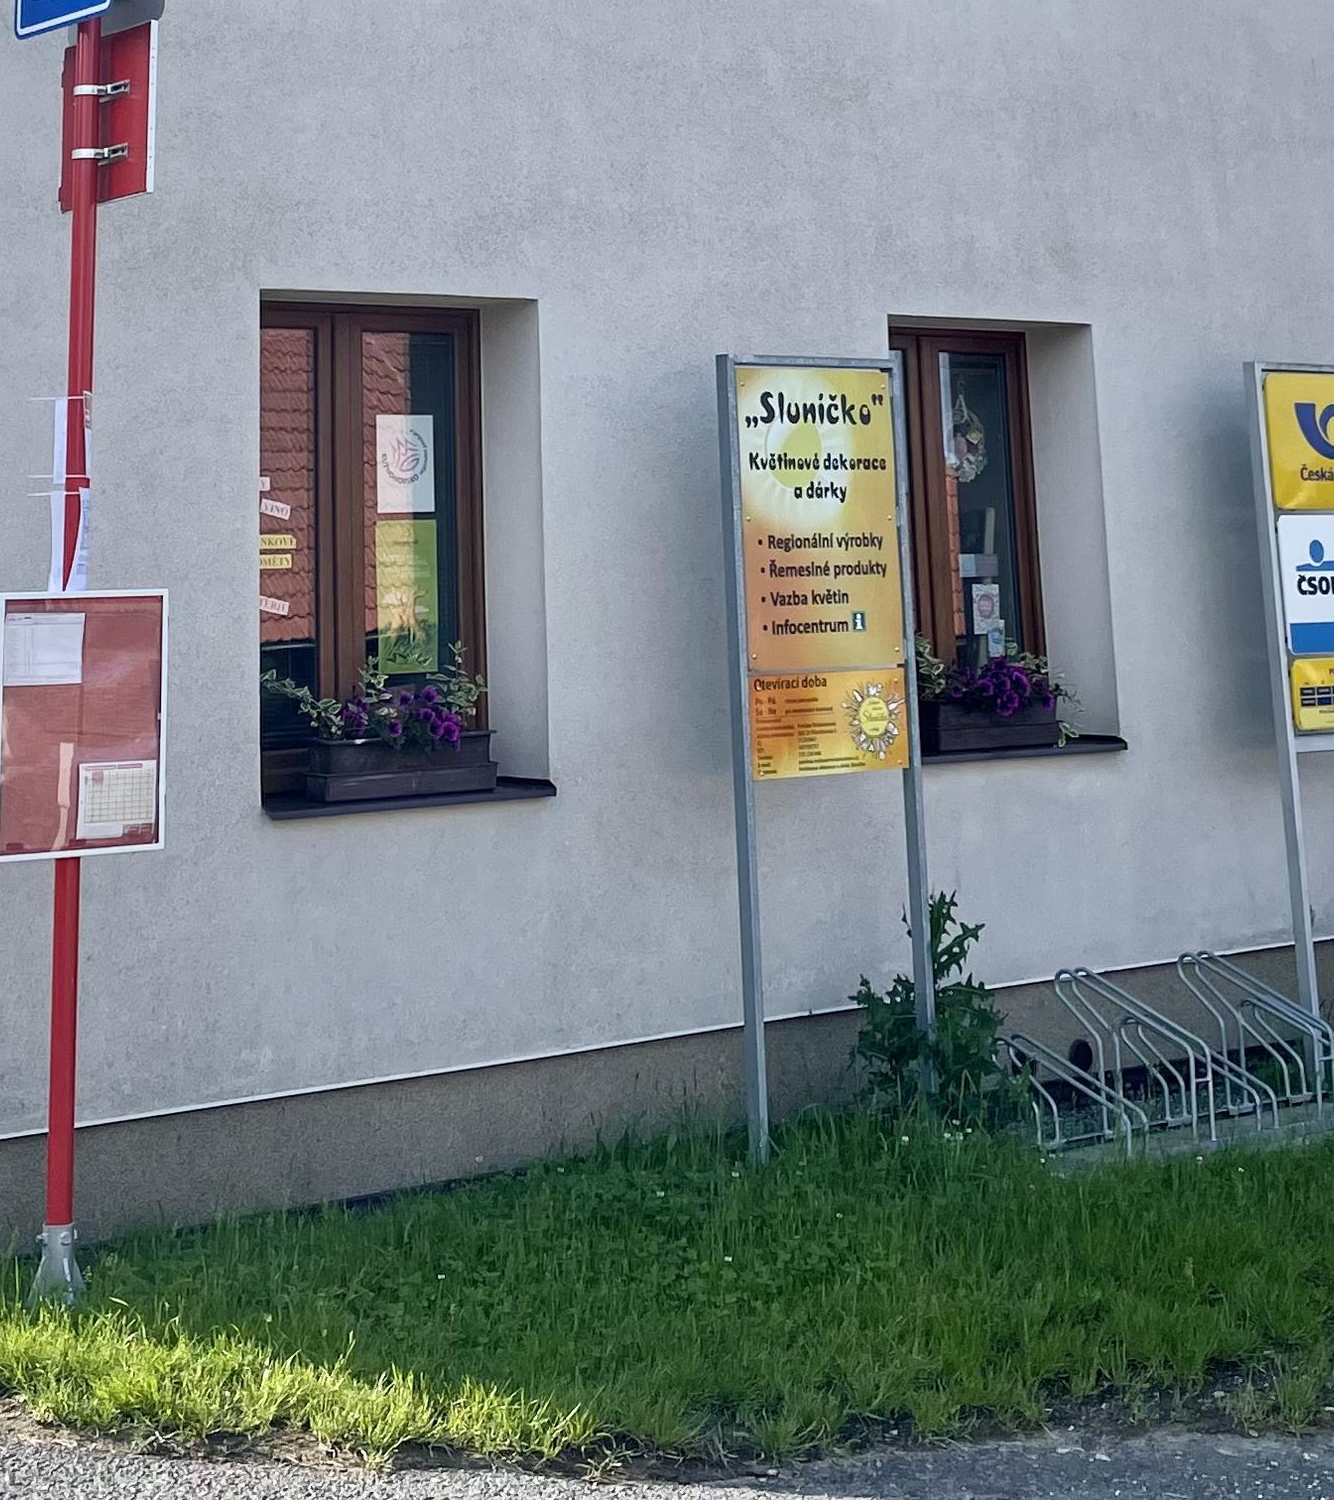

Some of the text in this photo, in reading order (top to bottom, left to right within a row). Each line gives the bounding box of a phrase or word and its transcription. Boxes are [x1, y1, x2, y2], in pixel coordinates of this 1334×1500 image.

[748, 451, 886, 471] Květinové dekorace
[1300, 464, 1334, 481] Česká
[794, 481, 847, 503] a dárky
[767, 532, 883, 553] Regionální výrobky
[769, 559, 887, 579] Řemeslné produkty
[770, 589, 849, 607] Vazba květin
[772, 618, 849, 636] Infocentrum
[801, 675, 827, 688] doba
